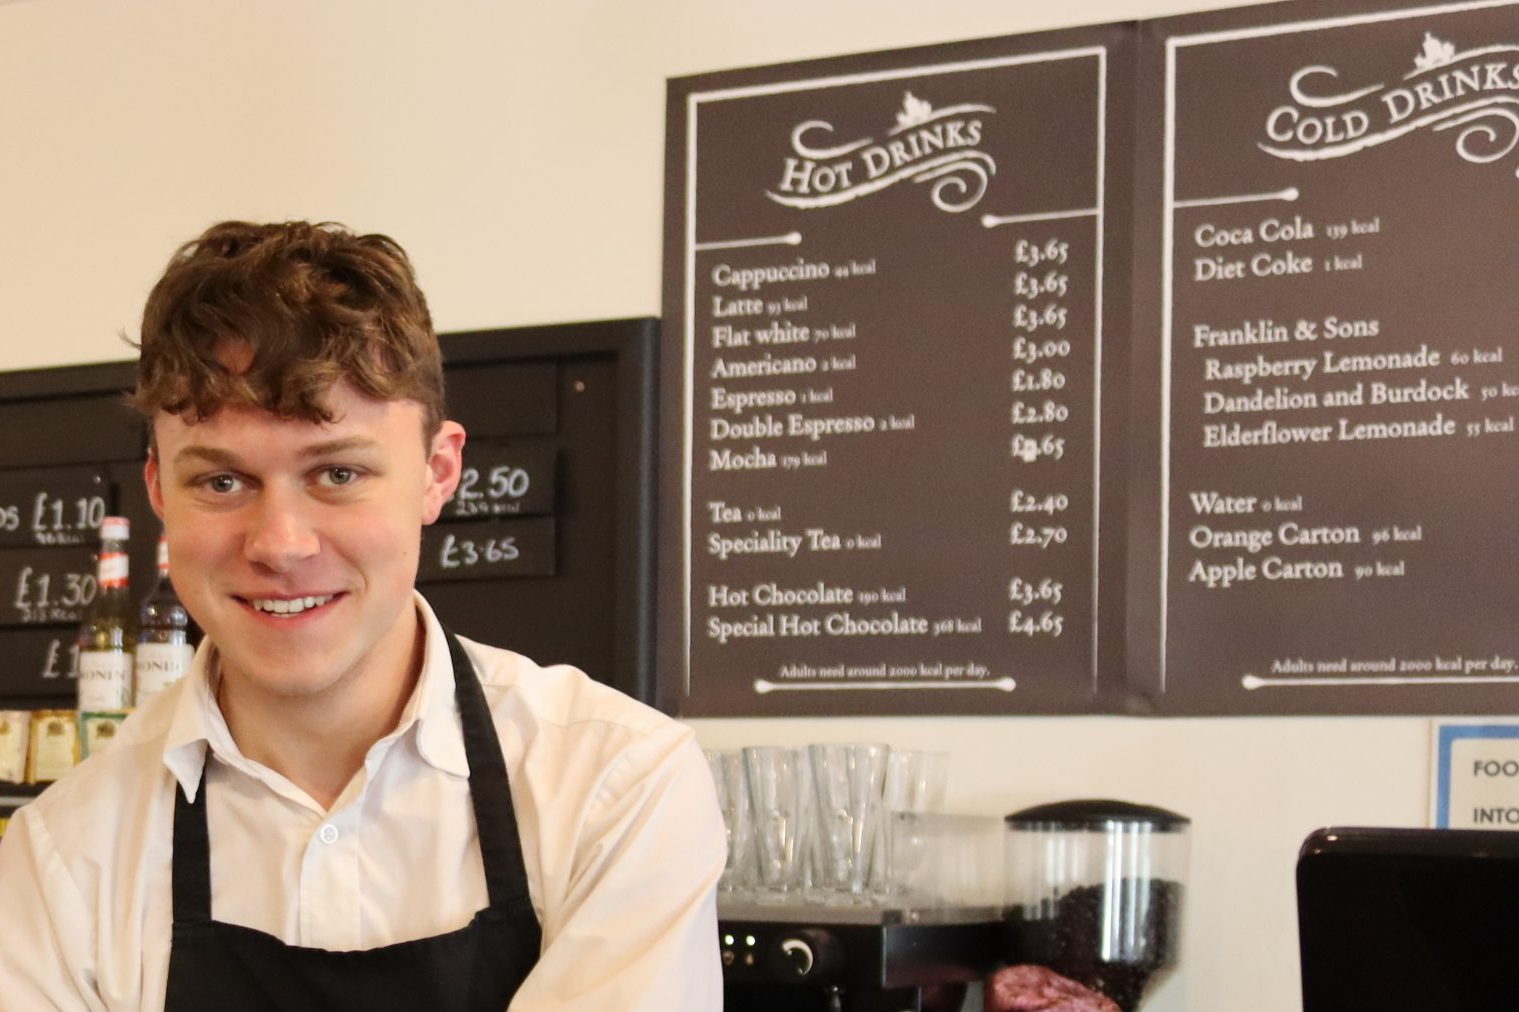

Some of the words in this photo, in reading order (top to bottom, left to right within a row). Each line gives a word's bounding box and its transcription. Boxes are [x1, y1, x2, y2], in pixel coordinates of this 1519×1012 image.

[1266, 106, 1369, 144] COLD
[781, 157, 853, 193] HOT
[863, 120, 982, 177] DRINKS
[1195, 225, 1253, 247] Coca
[1260, 216, 1313, 241] Cola
[1352, 218, 1379, 234] kcal
[713, 259, 829, 290] Cappuccino
[851, 260, 876, 274] kcal
[1016, 240, 1068, 266] £3.65
[1195, 257, 1244, 280] Diet
[1251, 251, 1312, 276] Coke
[1335, 254, 1362, 270] kcal
[713, 296, 763, 317] Latte
[784, 297, 807, 311] kcal
[1015, 272, 1067, 299] £3.65
[713, 326, 750, 347] Flat
[756, 322, 809, 343] white
[831, 324, 856, 339] kcal
[1015, 305, 1067, 331] £3.65
[1194, 320, 1288, 347] Franklin
[1295, 320, 1317, 340] &
[1324, 317, 1379, 338] Sons
[712, 354, 816, 378] Americano
[831, 355, 856, 370] kcal
[1014, 337, 1070, 363] £3.00
[1206, 355, 1317, 384] Raspberry
[1324, 345, 1440, 372] Lemonade
[1451, 352, 1469, 365] 60
[1473, 347, 1502, 363] kcal
[712, 388, 796, 414] Espresso
[809, 388, 833, 402] kcal
[1013, 369, 1065, 391] £1.80
[1205, 388, 1317, 413] Dandelion
[1323, 383, 1363, 407] and
[1371, 378, 1469, 404] Burdock
[711, 415, 783, 439] Double
[788, 414, 875, 440] Espresso
[890, 415, 914, 429] kcal
[1012, 401, 1068, 423] £2.80
[1204, 421, 1332, 447] Elderflower
[1339, 413, 1455, 440] Lemonade
[1485, 417, 1514, 432] kcal
[710, 447, 776, 470] Mocha
[802, 451, 827, 465] kcal
[450, 466, 530, 501] 2.50
[33, 493, 105, 531] £1.10
[709, 502, 742, 522] Tea
[757, 507, 781, 520] kcal
[1012, 490, 1068, 514] £2.40
[1190, 492, 1257, 513] Water
[1275, 496, 1302, 511] kcal
[709, 530, 802, 559] Speciality
[807, 529, 841, 550] Tea
[857, 535, 881, 548] kcal
[1011, 523, 1067, 548] £2.70
[1190, 526, 1272, 553] Orange
[1279, 523, 1360, 545] Carton
[1393, 526, 1421, 540] kcal
[16, 567, 97, 609] £1.30
[1189, 557, 1256, 588] Apple
[1262, 557, 1343, 579] Carton
[1376, 561, 1404, 576] kcal
[709, 586, 748, 606] Hot
[753, 583, 853, 605] Chocolate
[881, 588, 906, 602] kcal
[1010, 578, 1062, 605] £3.65
[709, 615, 774, 643] Special
[780, 615, 820, 636] Hot
[825, 612, 928, 635] Chocolate
[957, 618, 981, 632] kcal
[1010, 611, 1063, 636] £4.65
[781, 665, 816, 677] Adults
[819, 665, 844, 677] need
[847, 664, 886, 677] around
[920, 664, 942, 676] kcal
[944, 667, 964, 679] per
[1272, 659, 1314, 673] Adults
[1317, 659, 1347, 672] need
[1350, 658, 1395, 672] around
[1436, 657, 1462, 670] kcal
[1465, 661, 1487, 674] per
